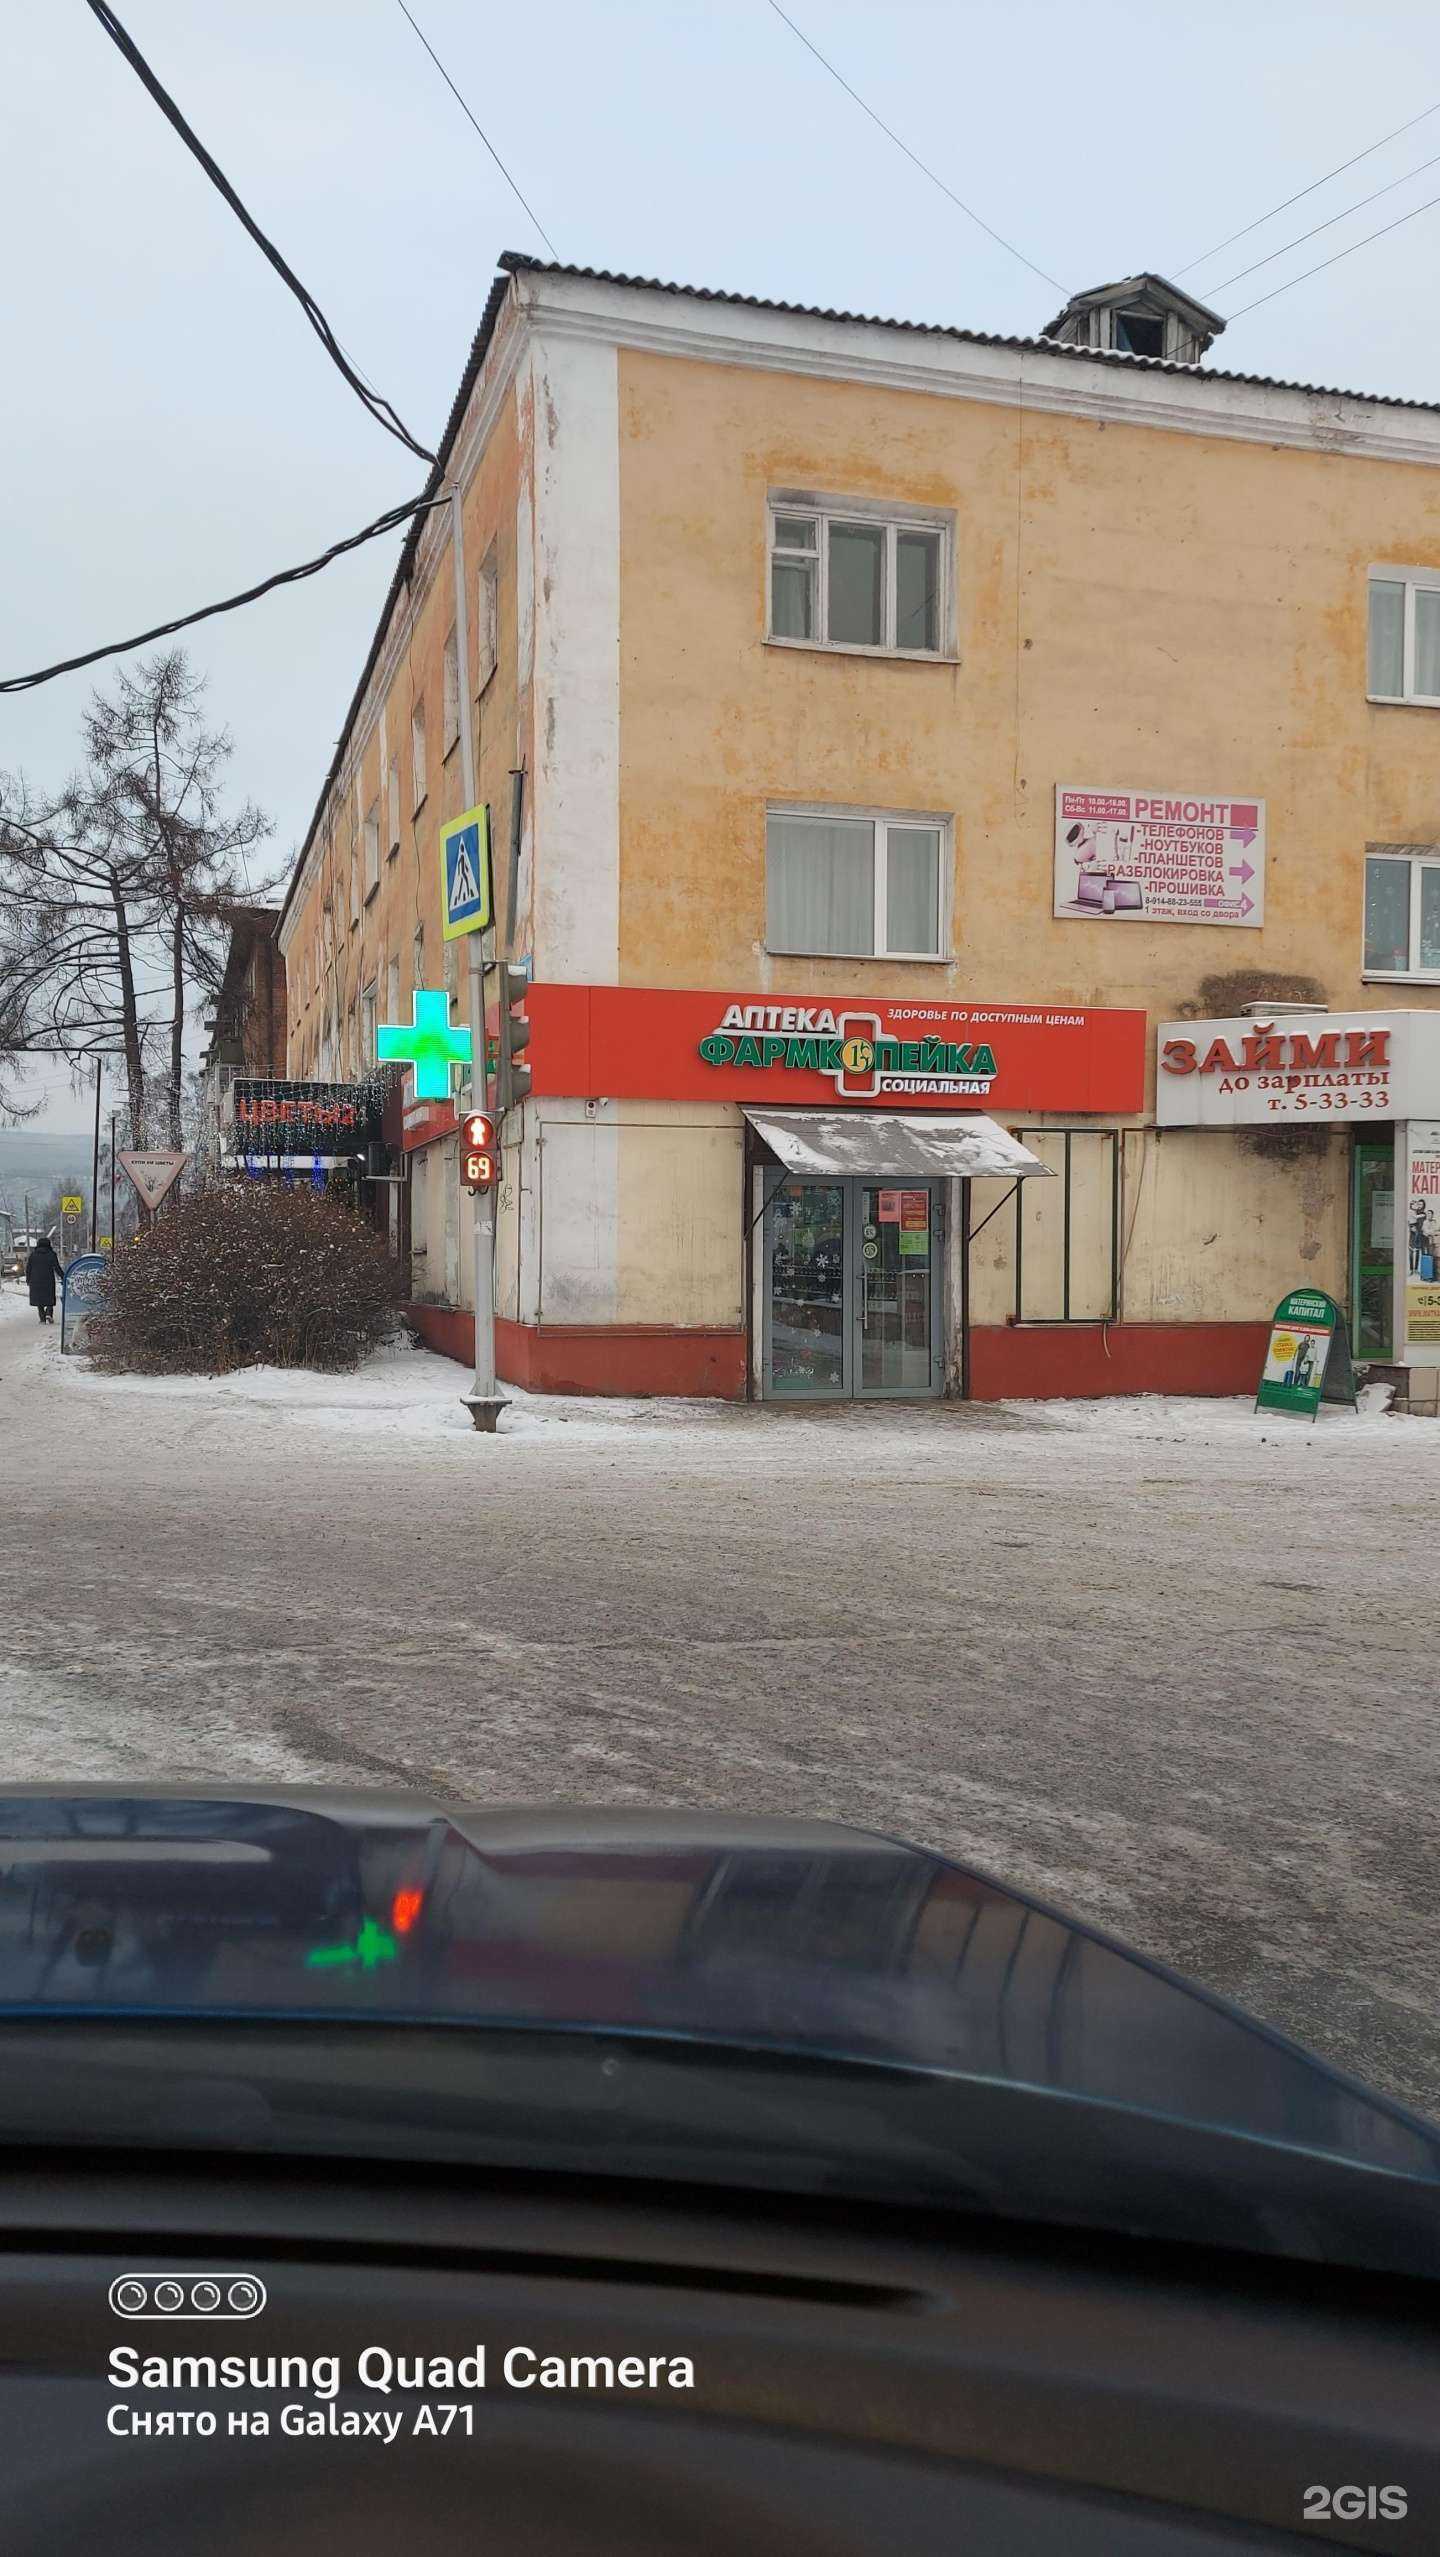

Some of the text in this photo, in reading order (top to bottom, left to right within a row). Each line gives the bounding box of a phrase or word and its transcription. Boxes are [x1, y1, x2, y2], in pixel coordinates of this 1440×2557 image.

[1135, 799, 1229, 823] РЕМОНТ
[720, 1004, 837, 1033] АПТЕКА
[887, 1008, 1085, 1026] ЗДОРОВЬЕ ПО ДОСТУПНЫМ ЦЕНАМ
[1160, 1022, 1391, 1076] ЗАЙМИ
[881, 1078, 991, 1095] СОЦИАЛЬНАЯ
[1218, 1071, 1389, 1094] до зарплаты
[1267, 1091, 1389, 1111] т. 5-33-33
[467, 1157, 491, 1180] 69
[1288, 1305, 1325, 1319] КАПИТАЛ
